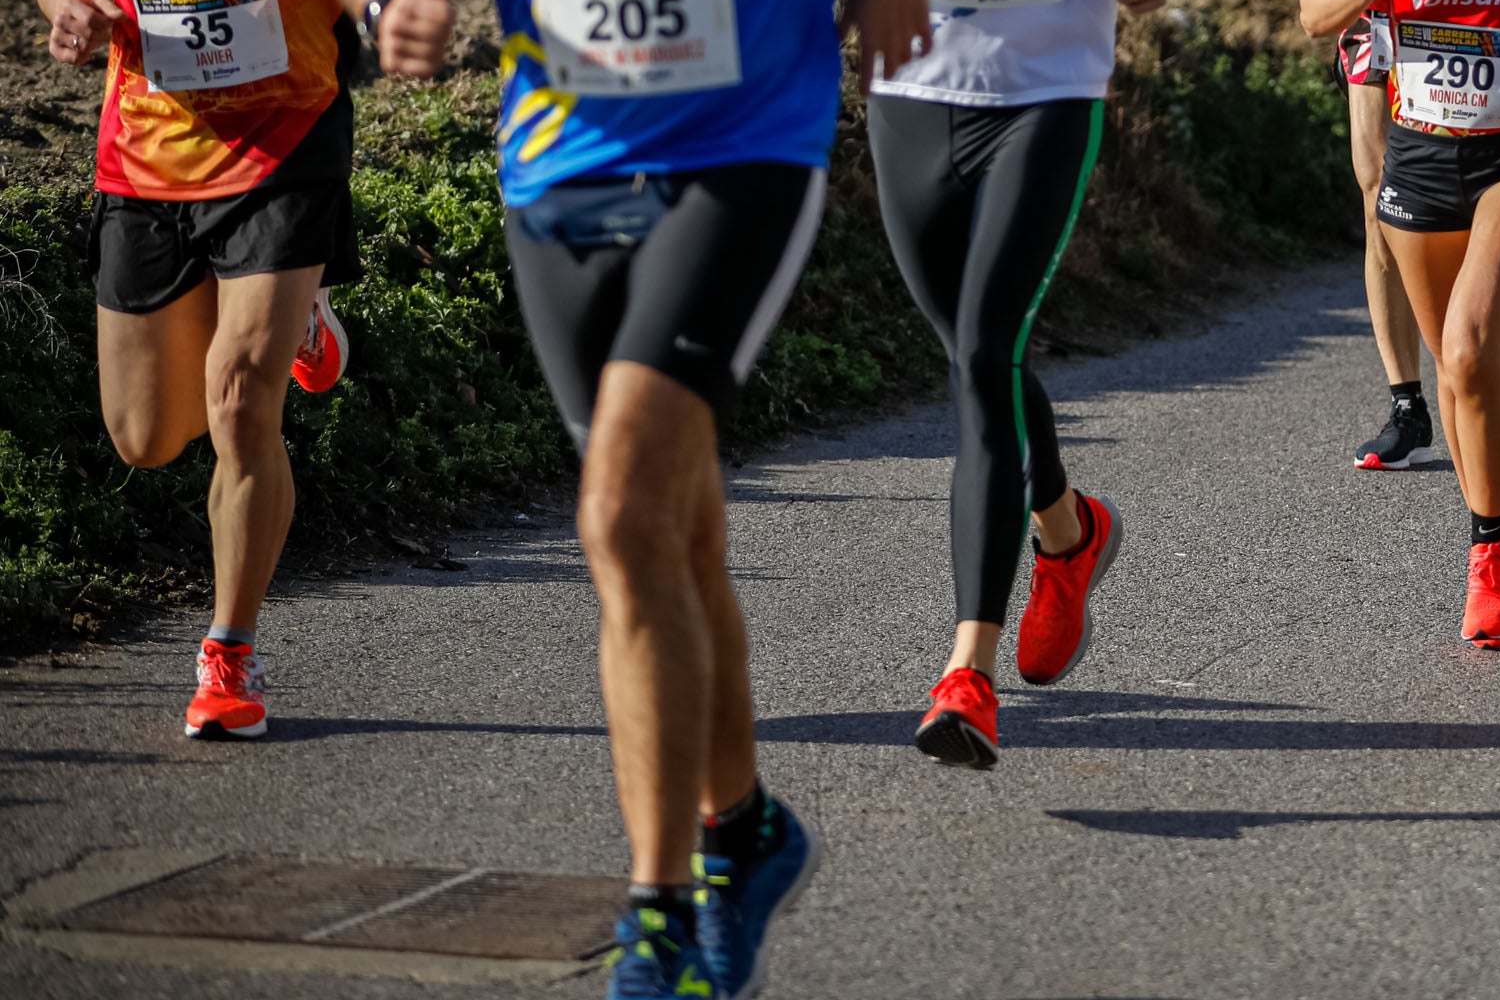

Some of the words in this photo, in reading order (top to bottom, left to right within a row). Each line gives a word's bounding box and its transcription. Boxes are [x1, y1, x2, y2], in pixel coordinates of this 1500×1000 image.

[182, 11, 233, 50] 35
[1401, 25, 1415, 35] 26
[1431, 28, 1480, 39] CARRERA
[1432, 35, 1479, 46] POPULAR
[195, 49, 234, 67] JAVIER
[1424, 53, 1495, 91] 290
[1429, 88, 1468, 105] MONICA
[1471, 93, 1488, 107] CM
[1452, 109, 1478, 118] olimpo
